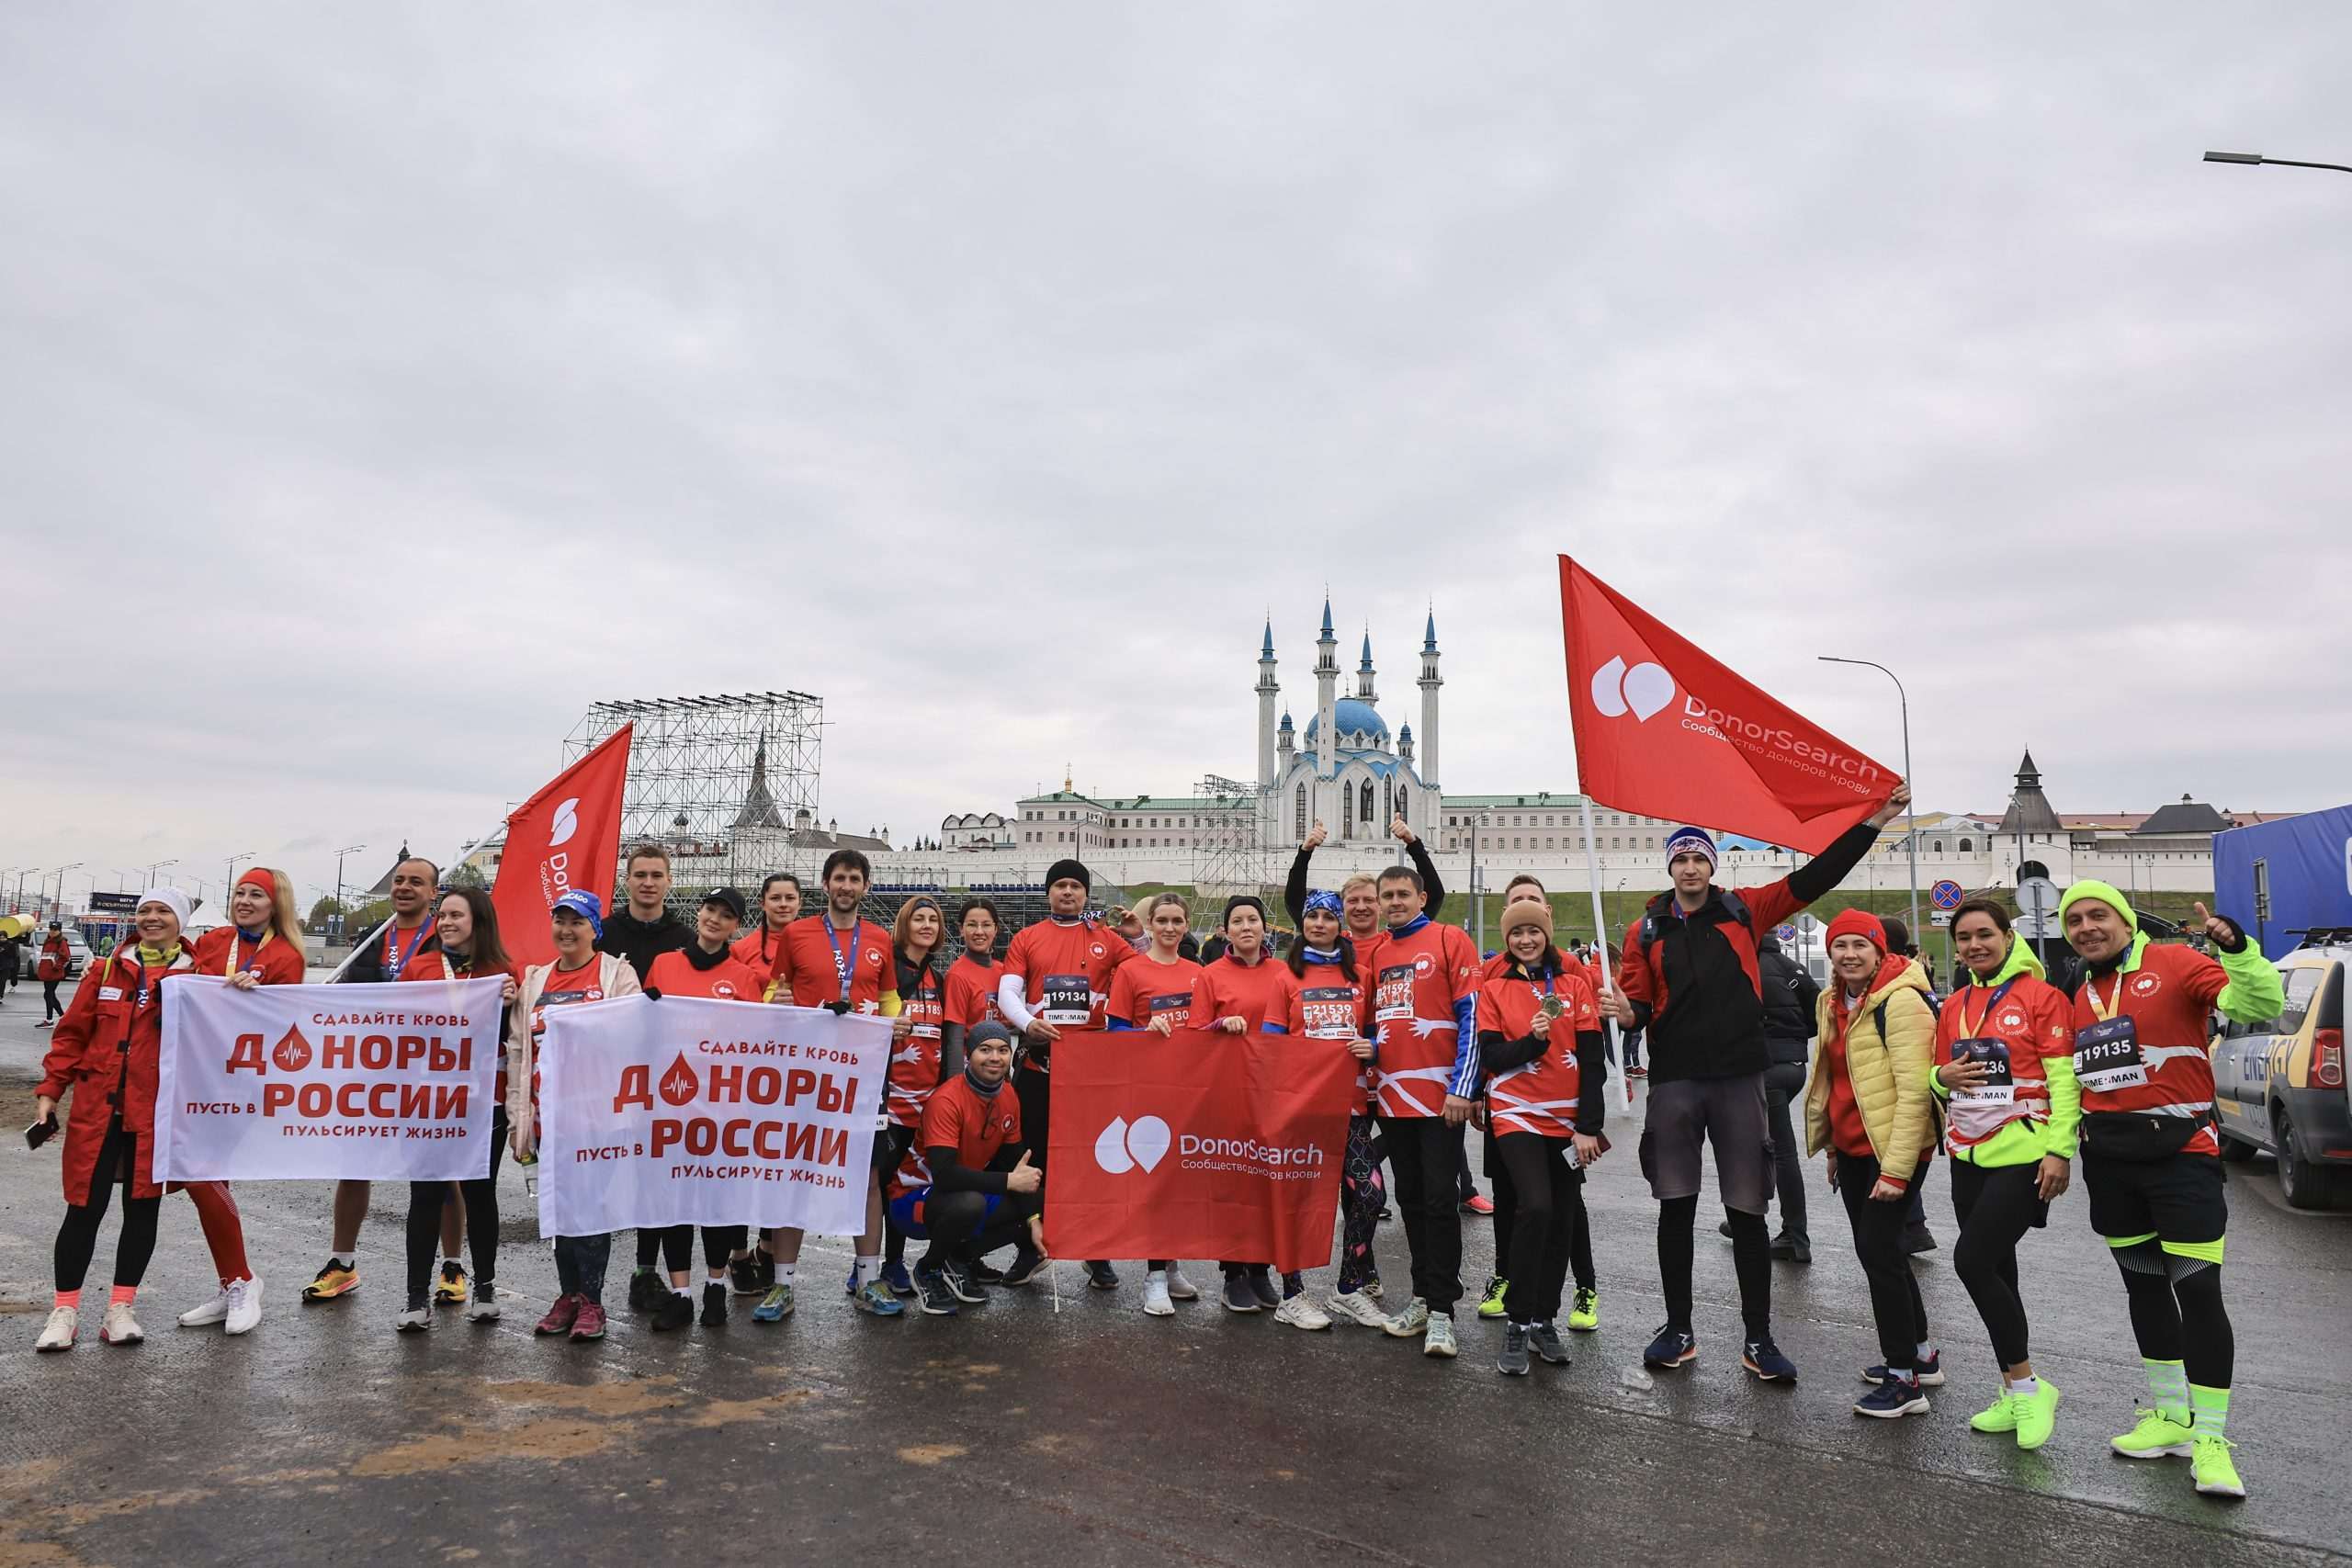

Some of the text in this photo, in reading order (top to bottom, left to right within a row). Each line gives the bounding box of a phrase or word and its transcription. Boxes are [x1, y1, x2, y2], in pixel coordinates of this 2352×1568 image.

[1684, 695, 1878, 782] DonorSearch
[1766, 750, 1826, 778] доноров
[1830, 773, 1871, 795] крови
[1051, 991, 1087, 1002] 19134
[312, 1011, 470, 1027] СДАВАЙТЕ КРОВЬ
[1312, 1003, 1352, 1015] 21539
[698, 1040, 859, 1066] СДАВАЙТЕ КРОВЬ
[2084, 1039, 2132, 1061] 19135
[187, 1082, 469, 1120] ПУСТЬ В РОССИИ
[283, 1125, 468, 1139] ПУЛЬСИРУЕТ ЖИЗНЬ
[576, 1117, 849, 1168] ПУСТЬ В РОССИИ
[1180, 1134, 1324, 1165] DonorSearch
[671, 1165, 846, 1189] ПУЛЬСИРУЕТ ЖИЗНЬ
[1247, 1166, 1283, 1180] доноов
[1285, 1170, 1321, 1181] крови
